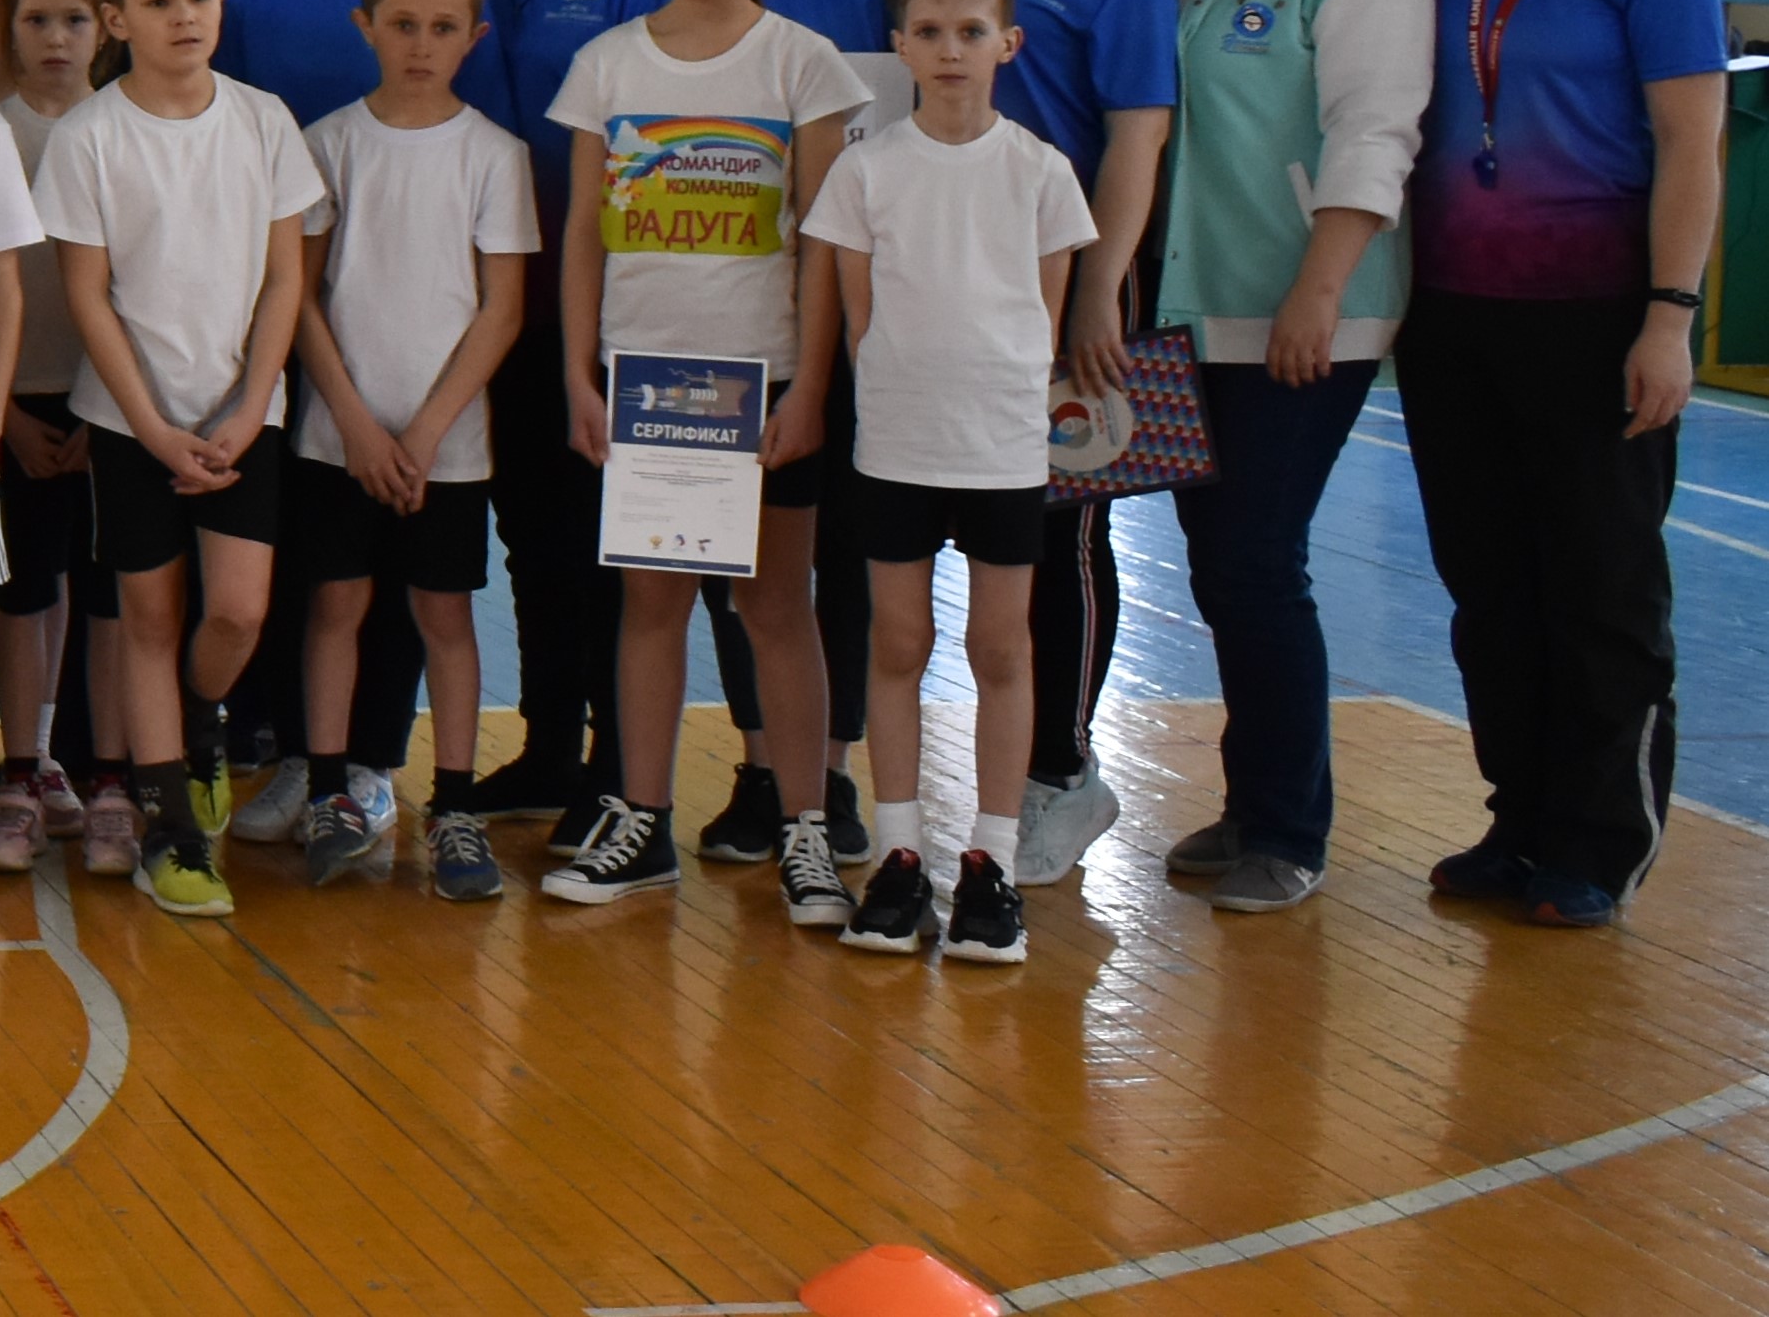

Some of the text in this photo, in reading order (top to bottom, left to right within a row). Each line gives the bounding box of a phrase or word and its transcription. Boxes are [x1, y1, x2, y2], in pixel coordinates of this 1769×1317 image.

[662, 155, 761, 175] КОМАНДИР
[666, 178, 759, 198] КОМАНДЫ
[625, 208, 759, 250] РАДУГА
[632, 422, 741, 444] СЕРТИФИКАТ
